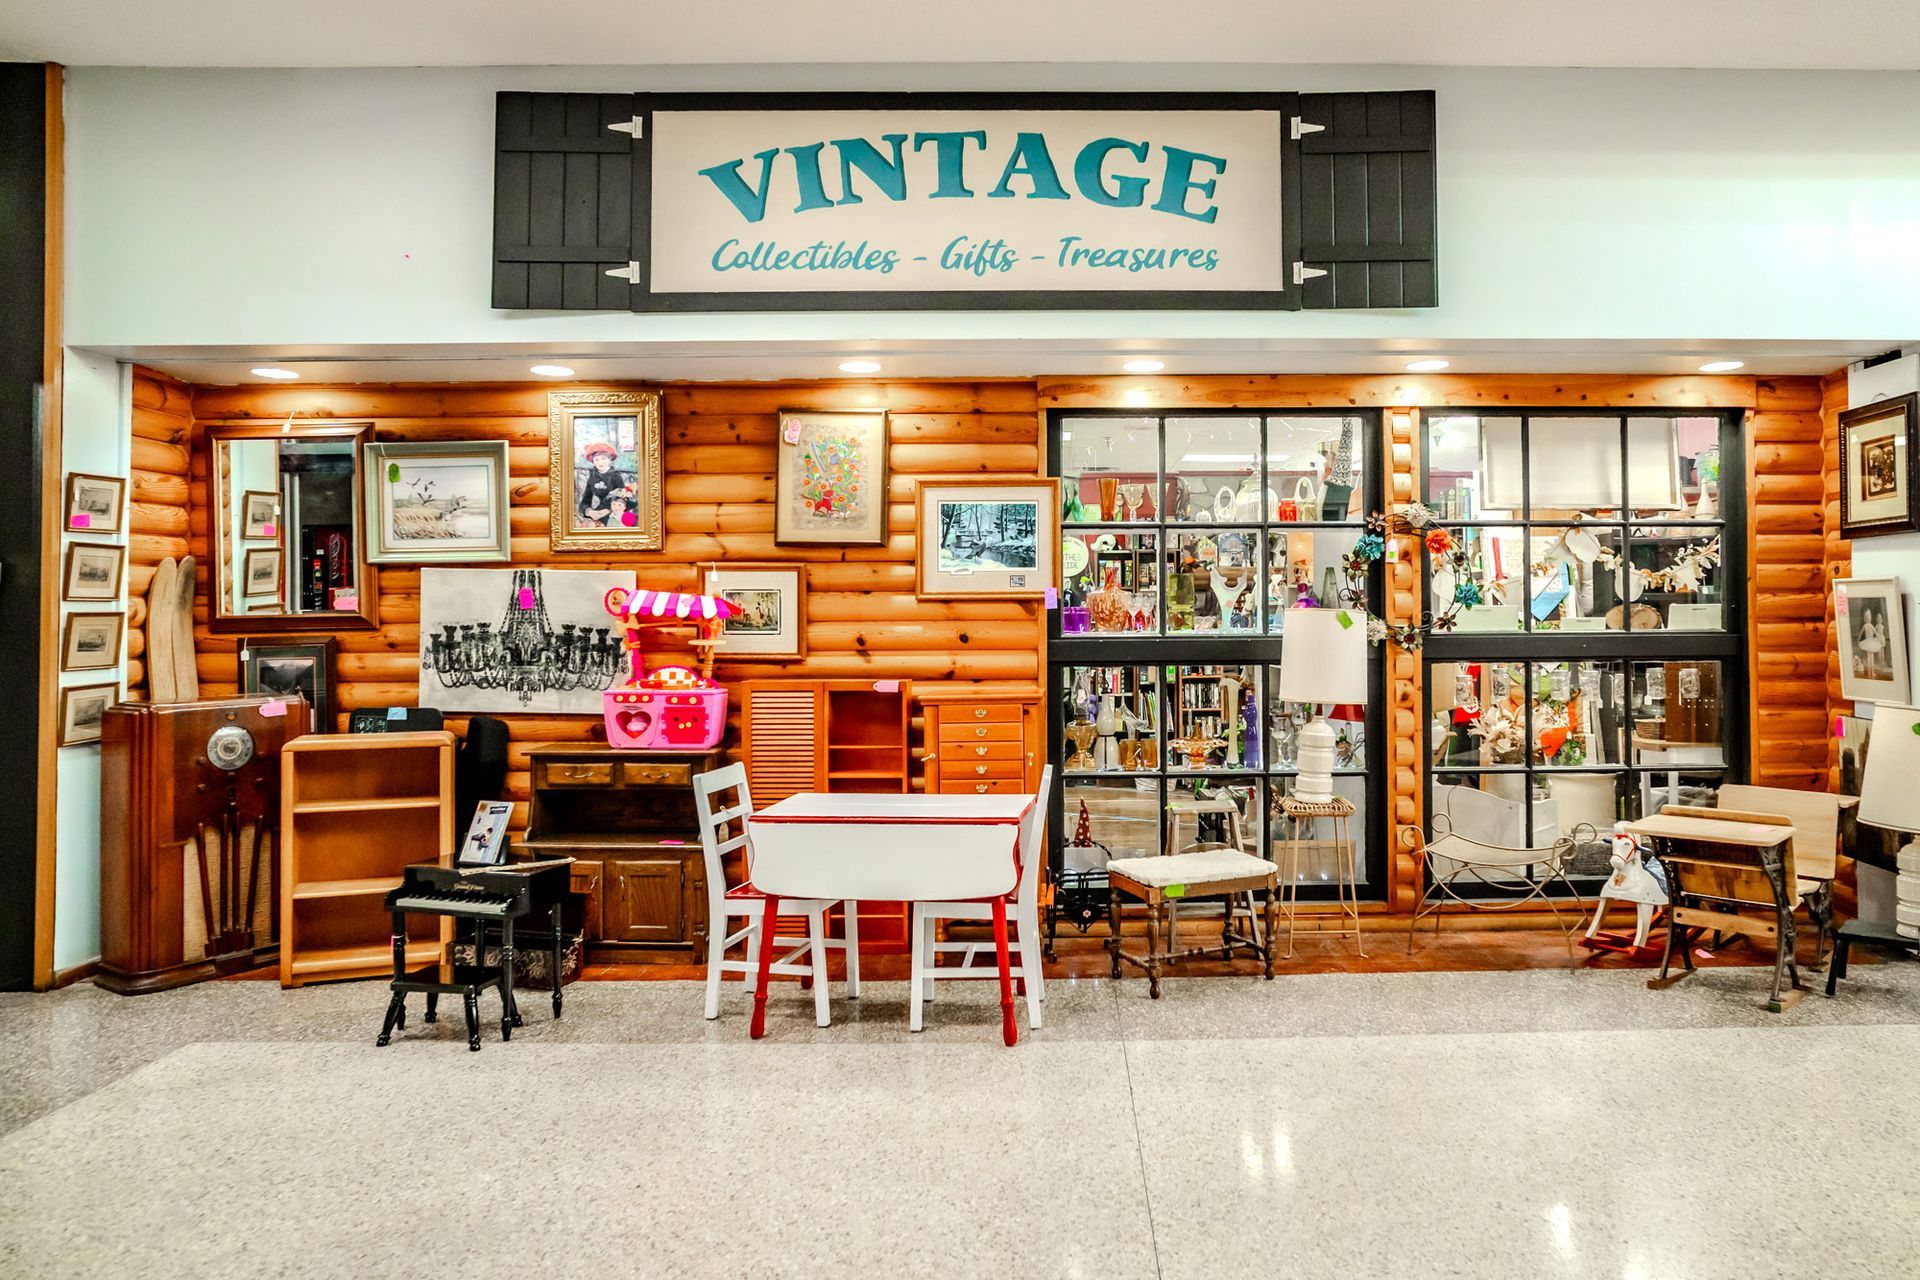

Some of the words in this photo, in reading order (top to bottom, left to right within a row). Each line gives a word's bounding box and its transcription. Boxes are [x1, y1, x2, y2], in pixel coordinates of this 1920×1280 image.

[697, 130, 1227, 224] VINTAGE
[711, 239, 899, 273] Collectibles
[941, 236, 1018, 276] Gifts
[1058, 236, 1220, 272] Treasures
